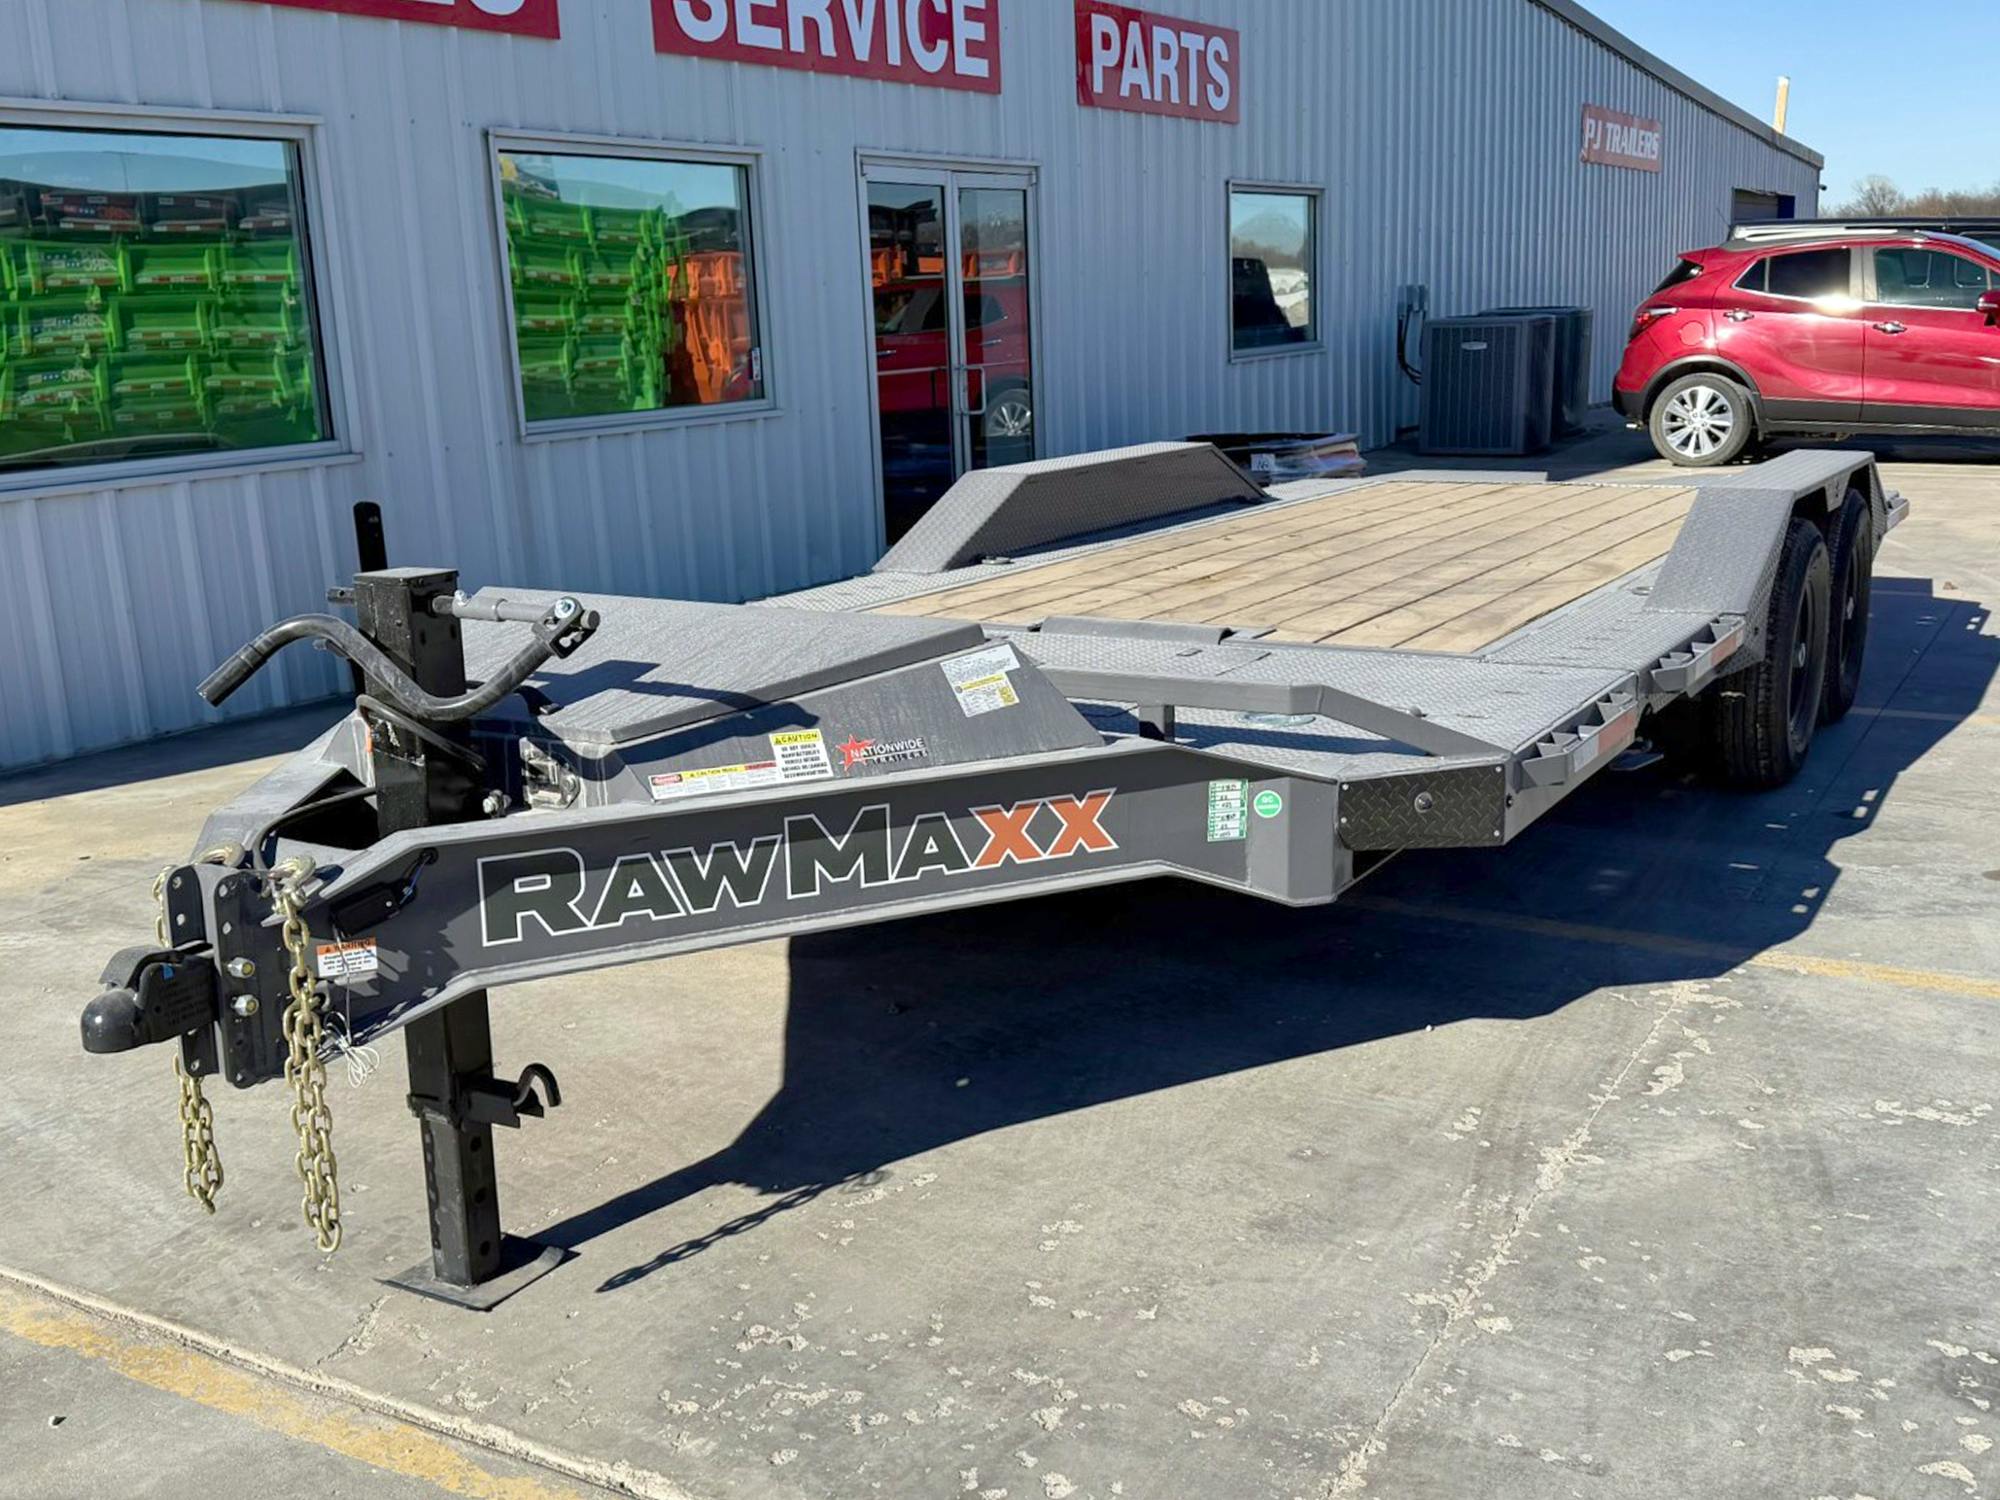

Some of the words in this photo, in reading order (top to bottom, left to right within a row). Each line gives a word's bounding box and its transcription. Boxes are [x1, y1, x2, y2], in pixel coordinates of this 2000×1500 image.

[1091, 12, 1230, 111] PARTS
[1584, 117, 1602, 150] PJ
[1605, 122, 1660, 160] TRAILERS
[781, 732, 818, 744] CAUTION
[850, 737, 925, 759] NATIONWIDE
